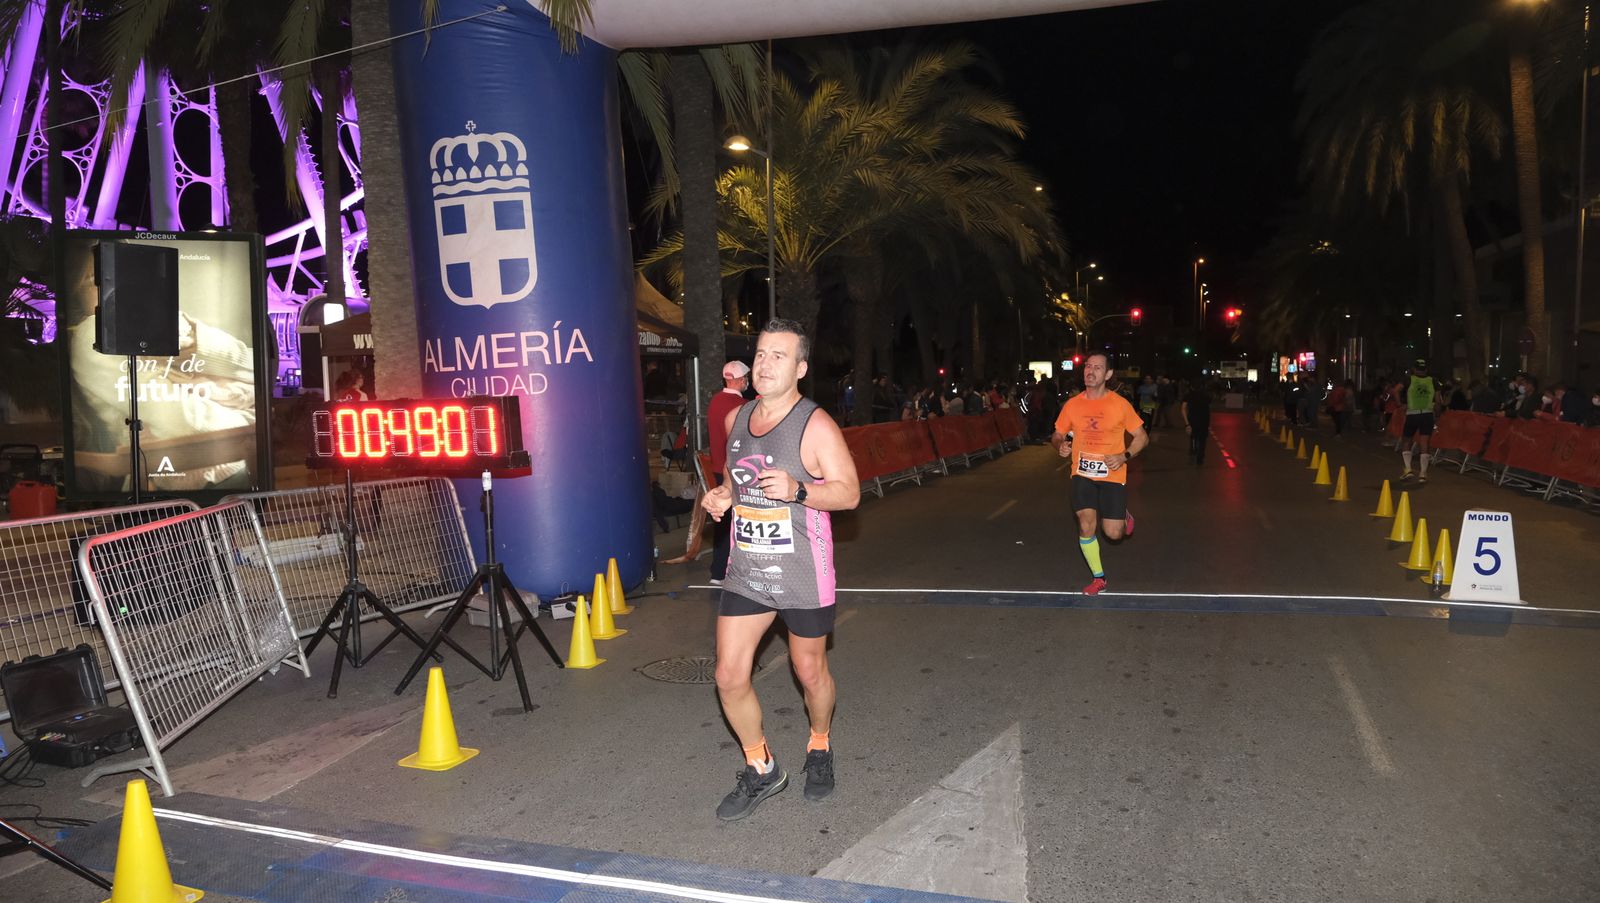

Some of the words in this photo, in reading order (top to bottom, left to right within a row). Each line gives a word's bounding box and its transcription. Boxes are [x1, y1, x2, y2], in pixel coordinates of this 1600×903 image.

[135, 232, 177, 240] JCDecaux
[425, 320, 593, 373] ALMERÍA
[180, 353, 205, 373] de
[114, 375, 212, 402] futuro
[451, 372, 548, 399] CIUDAD
[1083, 460, 1103, 470] 567
[1468, 514, 1509, 522] MONDO
[743, 521, 781, 538] 412
[1473, 536, 1502, 576] 5
